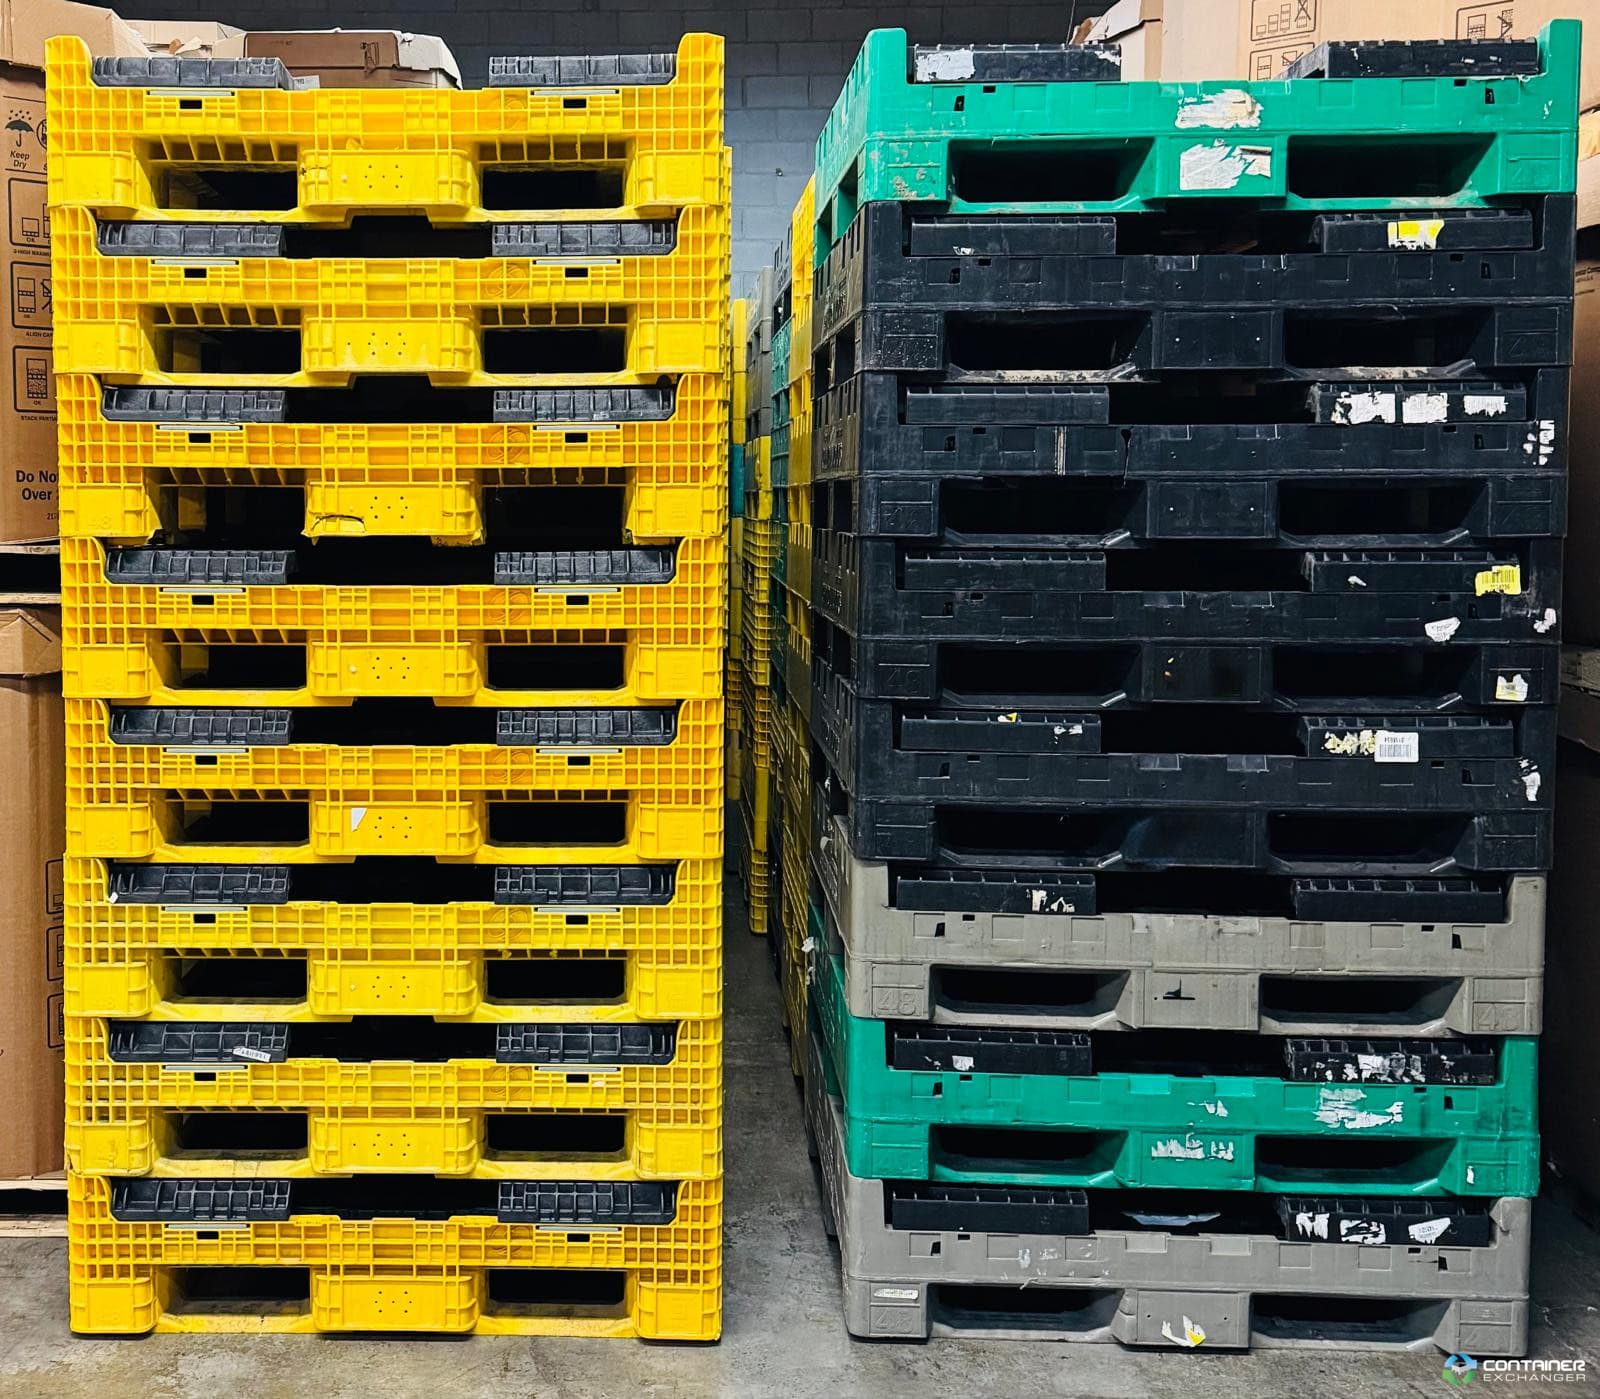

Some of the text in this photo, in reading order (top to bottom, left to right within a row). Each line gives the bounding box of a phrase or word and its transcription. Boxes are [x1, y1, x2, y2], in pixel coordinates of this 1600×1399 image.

[10, 150, 30, 161] Keep
[13, 159, 27, 170] Dry
[15, 470, 35, 483] Do
[21, 487, 52, 501] Over
